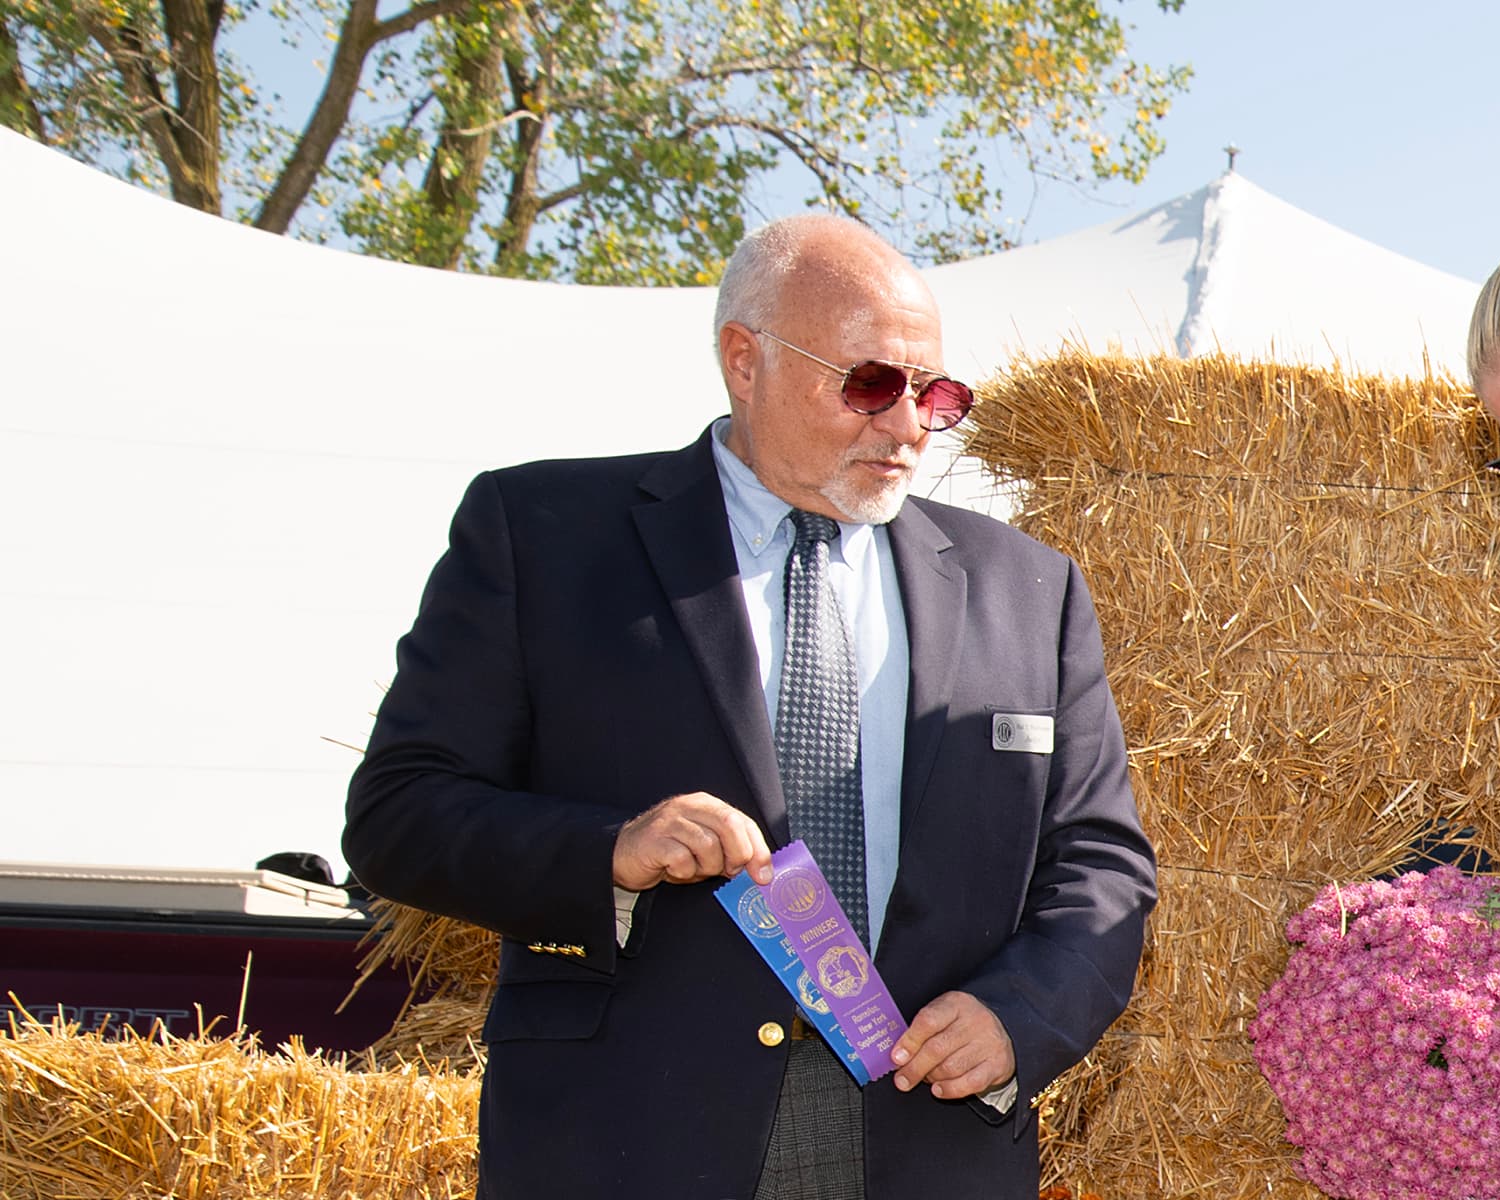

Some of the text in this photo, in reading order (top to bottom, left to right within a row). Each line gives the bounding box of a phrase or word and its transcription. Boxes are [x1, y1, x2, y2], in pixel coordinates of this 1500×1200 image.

[800, 917, 839, 944] WINNERS
[858, 1020, 873, 1034] New
[871, 1014, 888, 1026] York
[857, 1026, 889, 1050] September
[877, 1037, 894, 1052] 2025
